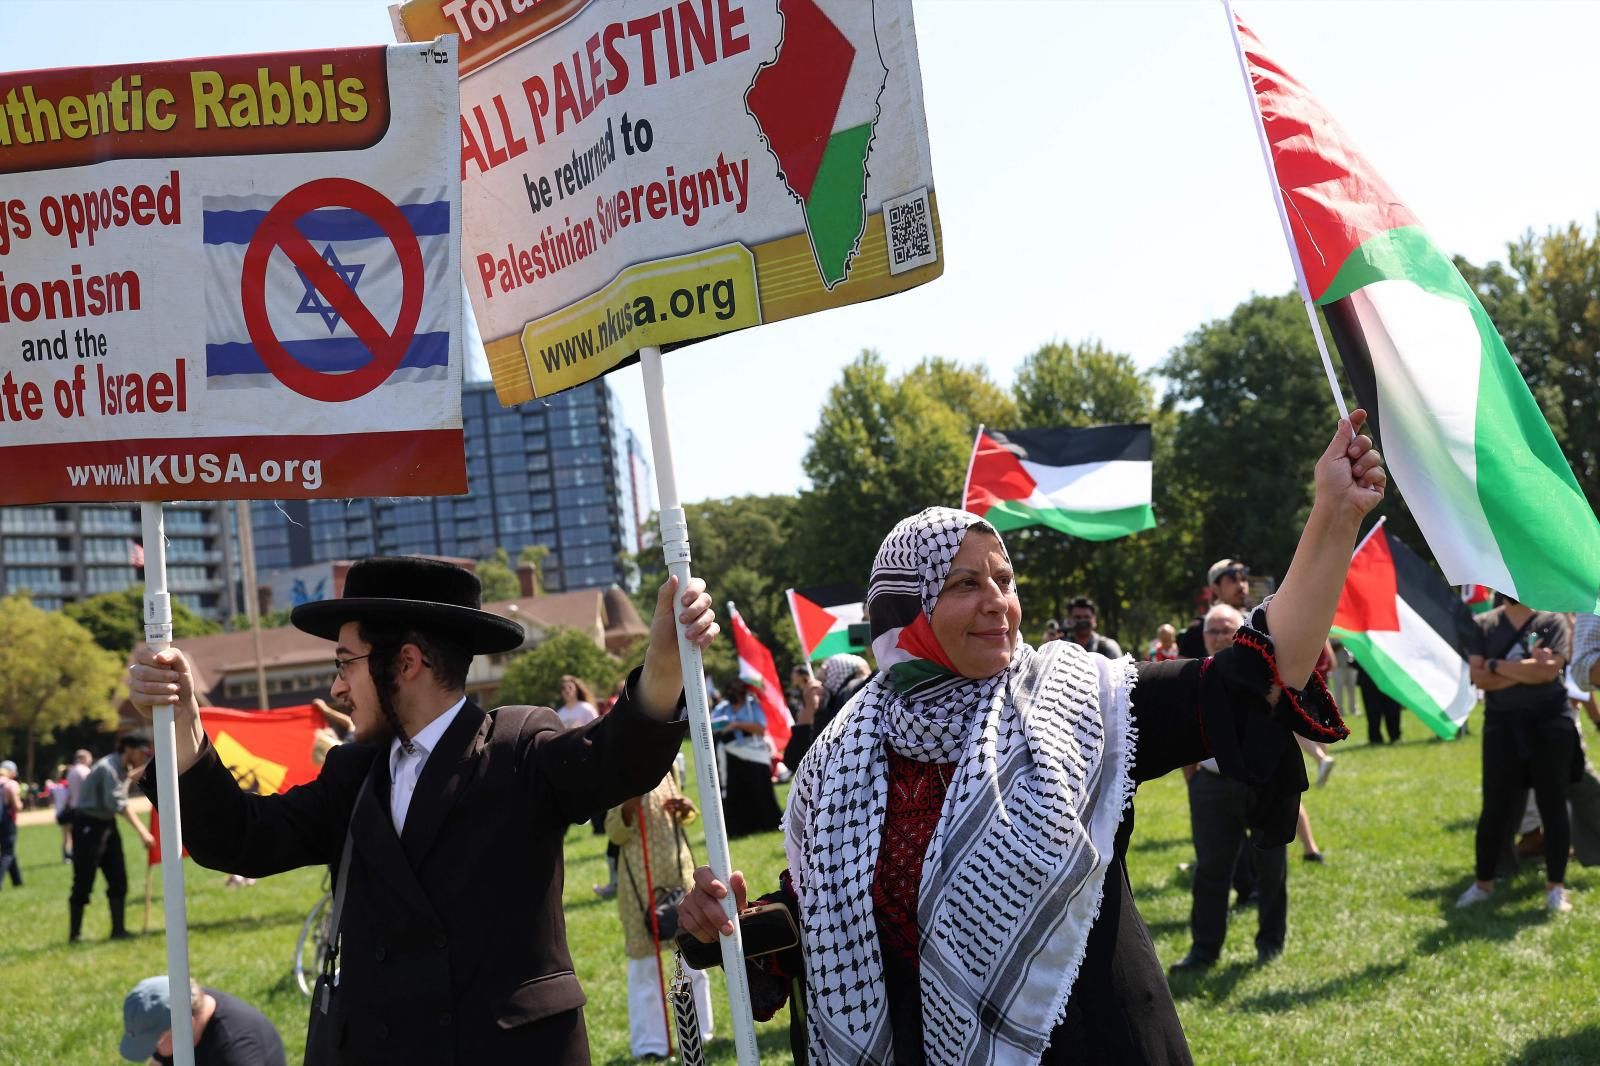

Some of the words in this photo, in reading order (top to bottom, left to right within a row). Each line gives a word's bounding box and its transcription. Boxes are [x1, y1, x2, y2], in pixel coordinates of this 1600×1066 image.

[190, 63, 368, 129] Rabbis
[459, 94, 528, 181] ALL
[522, 0, 751, 145] PALESTINE
[523, 173, 553, 214] be
[554, 117, 616, 200] returned
[619, 112, 654, 157] to
[40, 170, 181, 248] opposed
[476, 215, 598, 299] Palestinian
[595, 152, 750, 245] Sovereignty
[22, 331, 68, 362] and
[74, 328, 108, 358] the
[539, 278, 736, 374] www.nkusa.org
[0, 370, 44, 422] te
[53, 365, 87, 419] of
[97, 358, 187, 417] Israel
[66, 453, 323, 490] www.NKUSA.org
